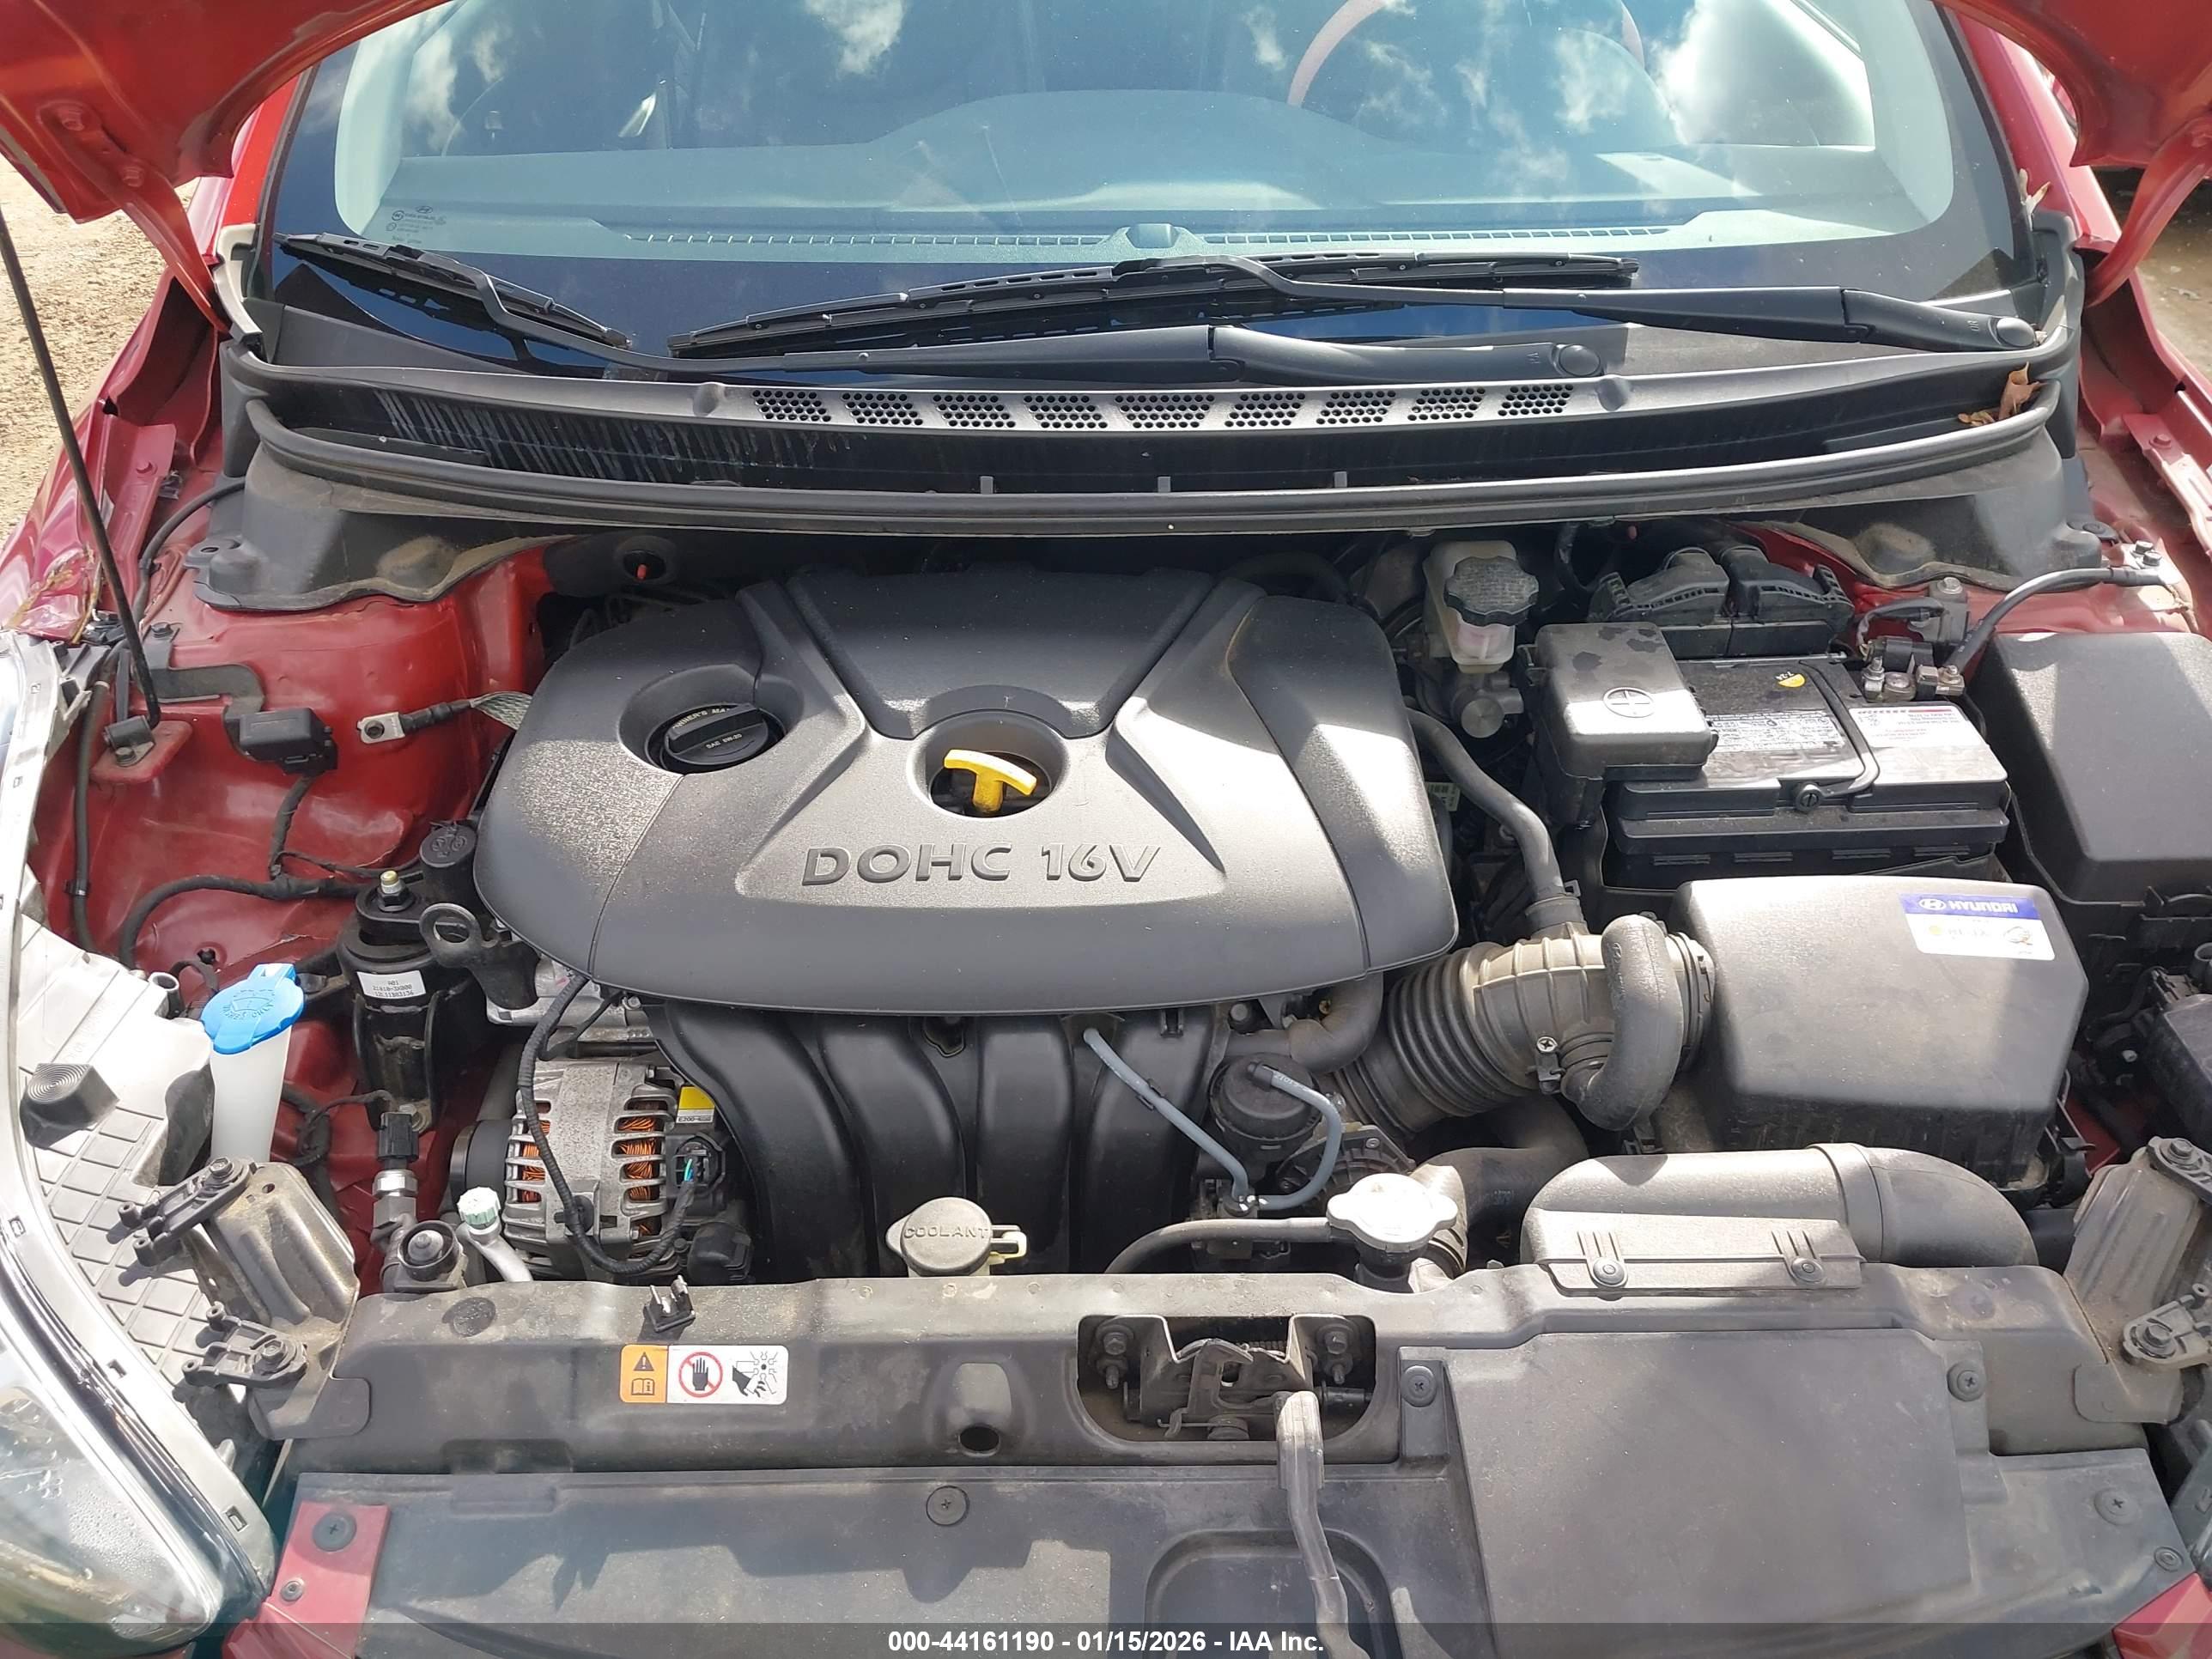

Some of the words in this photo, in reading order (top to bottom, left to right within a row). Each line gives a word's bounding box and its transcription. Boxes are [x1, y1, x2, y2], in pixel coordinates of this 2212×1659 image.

[705, 740, 721, 749] SAE
[801, 842, 1013, 885] DOHC
[1041, 842, 1161, 883] 16V
[1948, 899, 2019, 914] HYUNDAI
[903, 1224, 988, 1239] COOLANT
